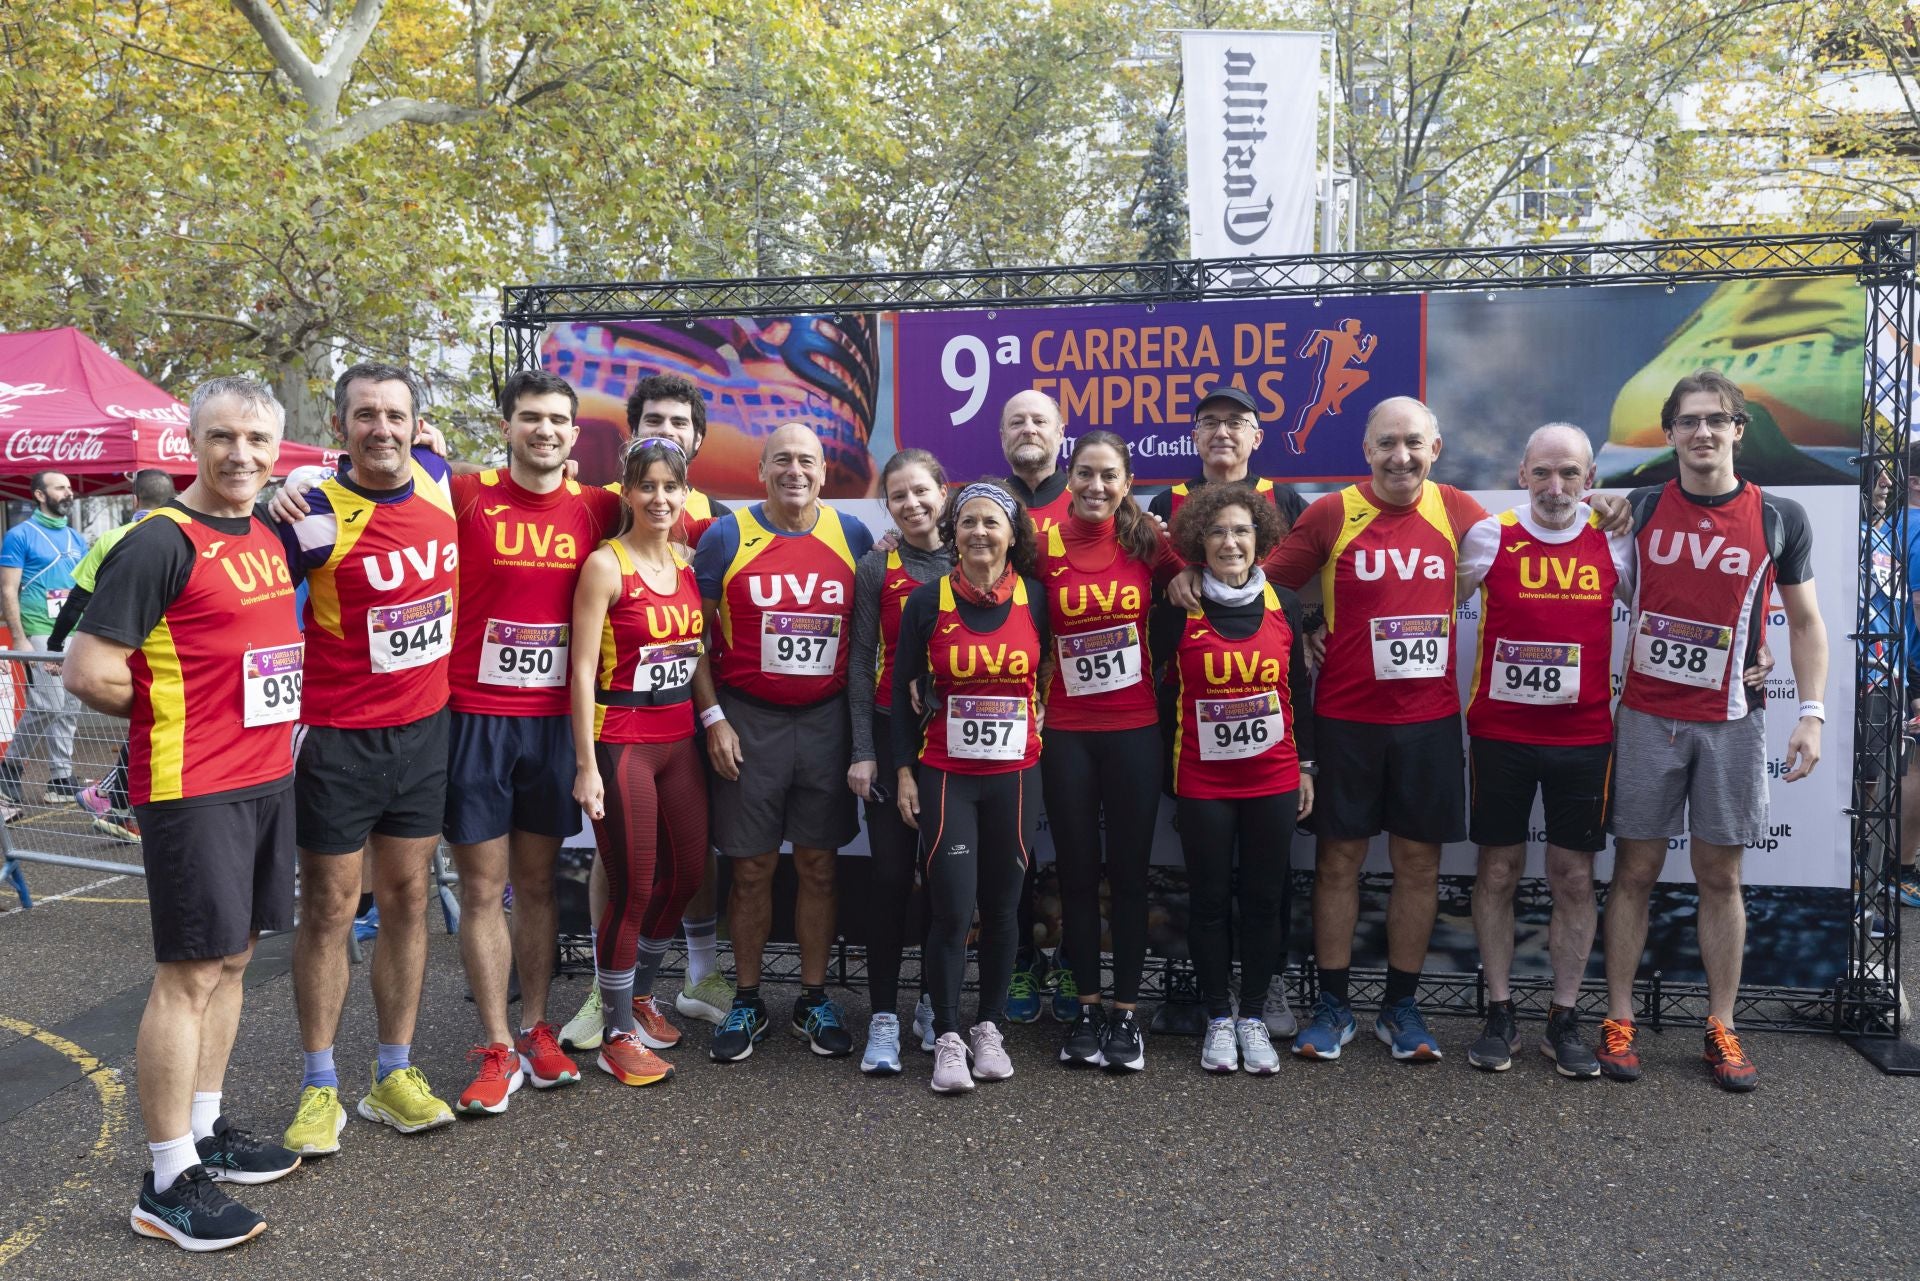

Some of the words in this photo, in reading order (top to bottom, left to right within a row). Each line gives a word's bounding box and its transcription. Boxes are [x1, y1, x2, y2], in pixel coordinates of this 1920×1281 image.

[1224, 47, 1274, 246] Castilla
[940, 334, 1021, 426] 9ª
[1031, 325, 1219, 372] CARRERA
[1234, 322, 1287, 366] DE
[6, 427, 111, 461] Coca-Cola
[495, 522, 576, 559] UVa
[1648, 529, 1750, 576] UVa
[220, 549, 291, 592] UVa
[363, 539, 458, 592] UVa
[1355, 549, 1445, 580] UVa
[1520, 557, 1600, 590] UVa
[749, 573, 844, 607] UVa
[1060, 581, 1141, 617] UVa
[646, 604, 703, 638] UVa
[390, 620, 443, 657] 944
[778, 636, 828, 662] 937
[1390, 639, 1438, 665] 949
[499, 647, 553, 674] 950
[950, 644, 1029, 677] UVa
[1076, 650, 1126, 682] 951
[1204, 651, 1280, 685] UVa
[1650, 639, 1708, 673] 938
[650, 660, 689, 691] 945
[1505, 665, 1561, 692] 948
[963, 720, 1013, 746] 957
[1214, 719, 1268, 747] 946
